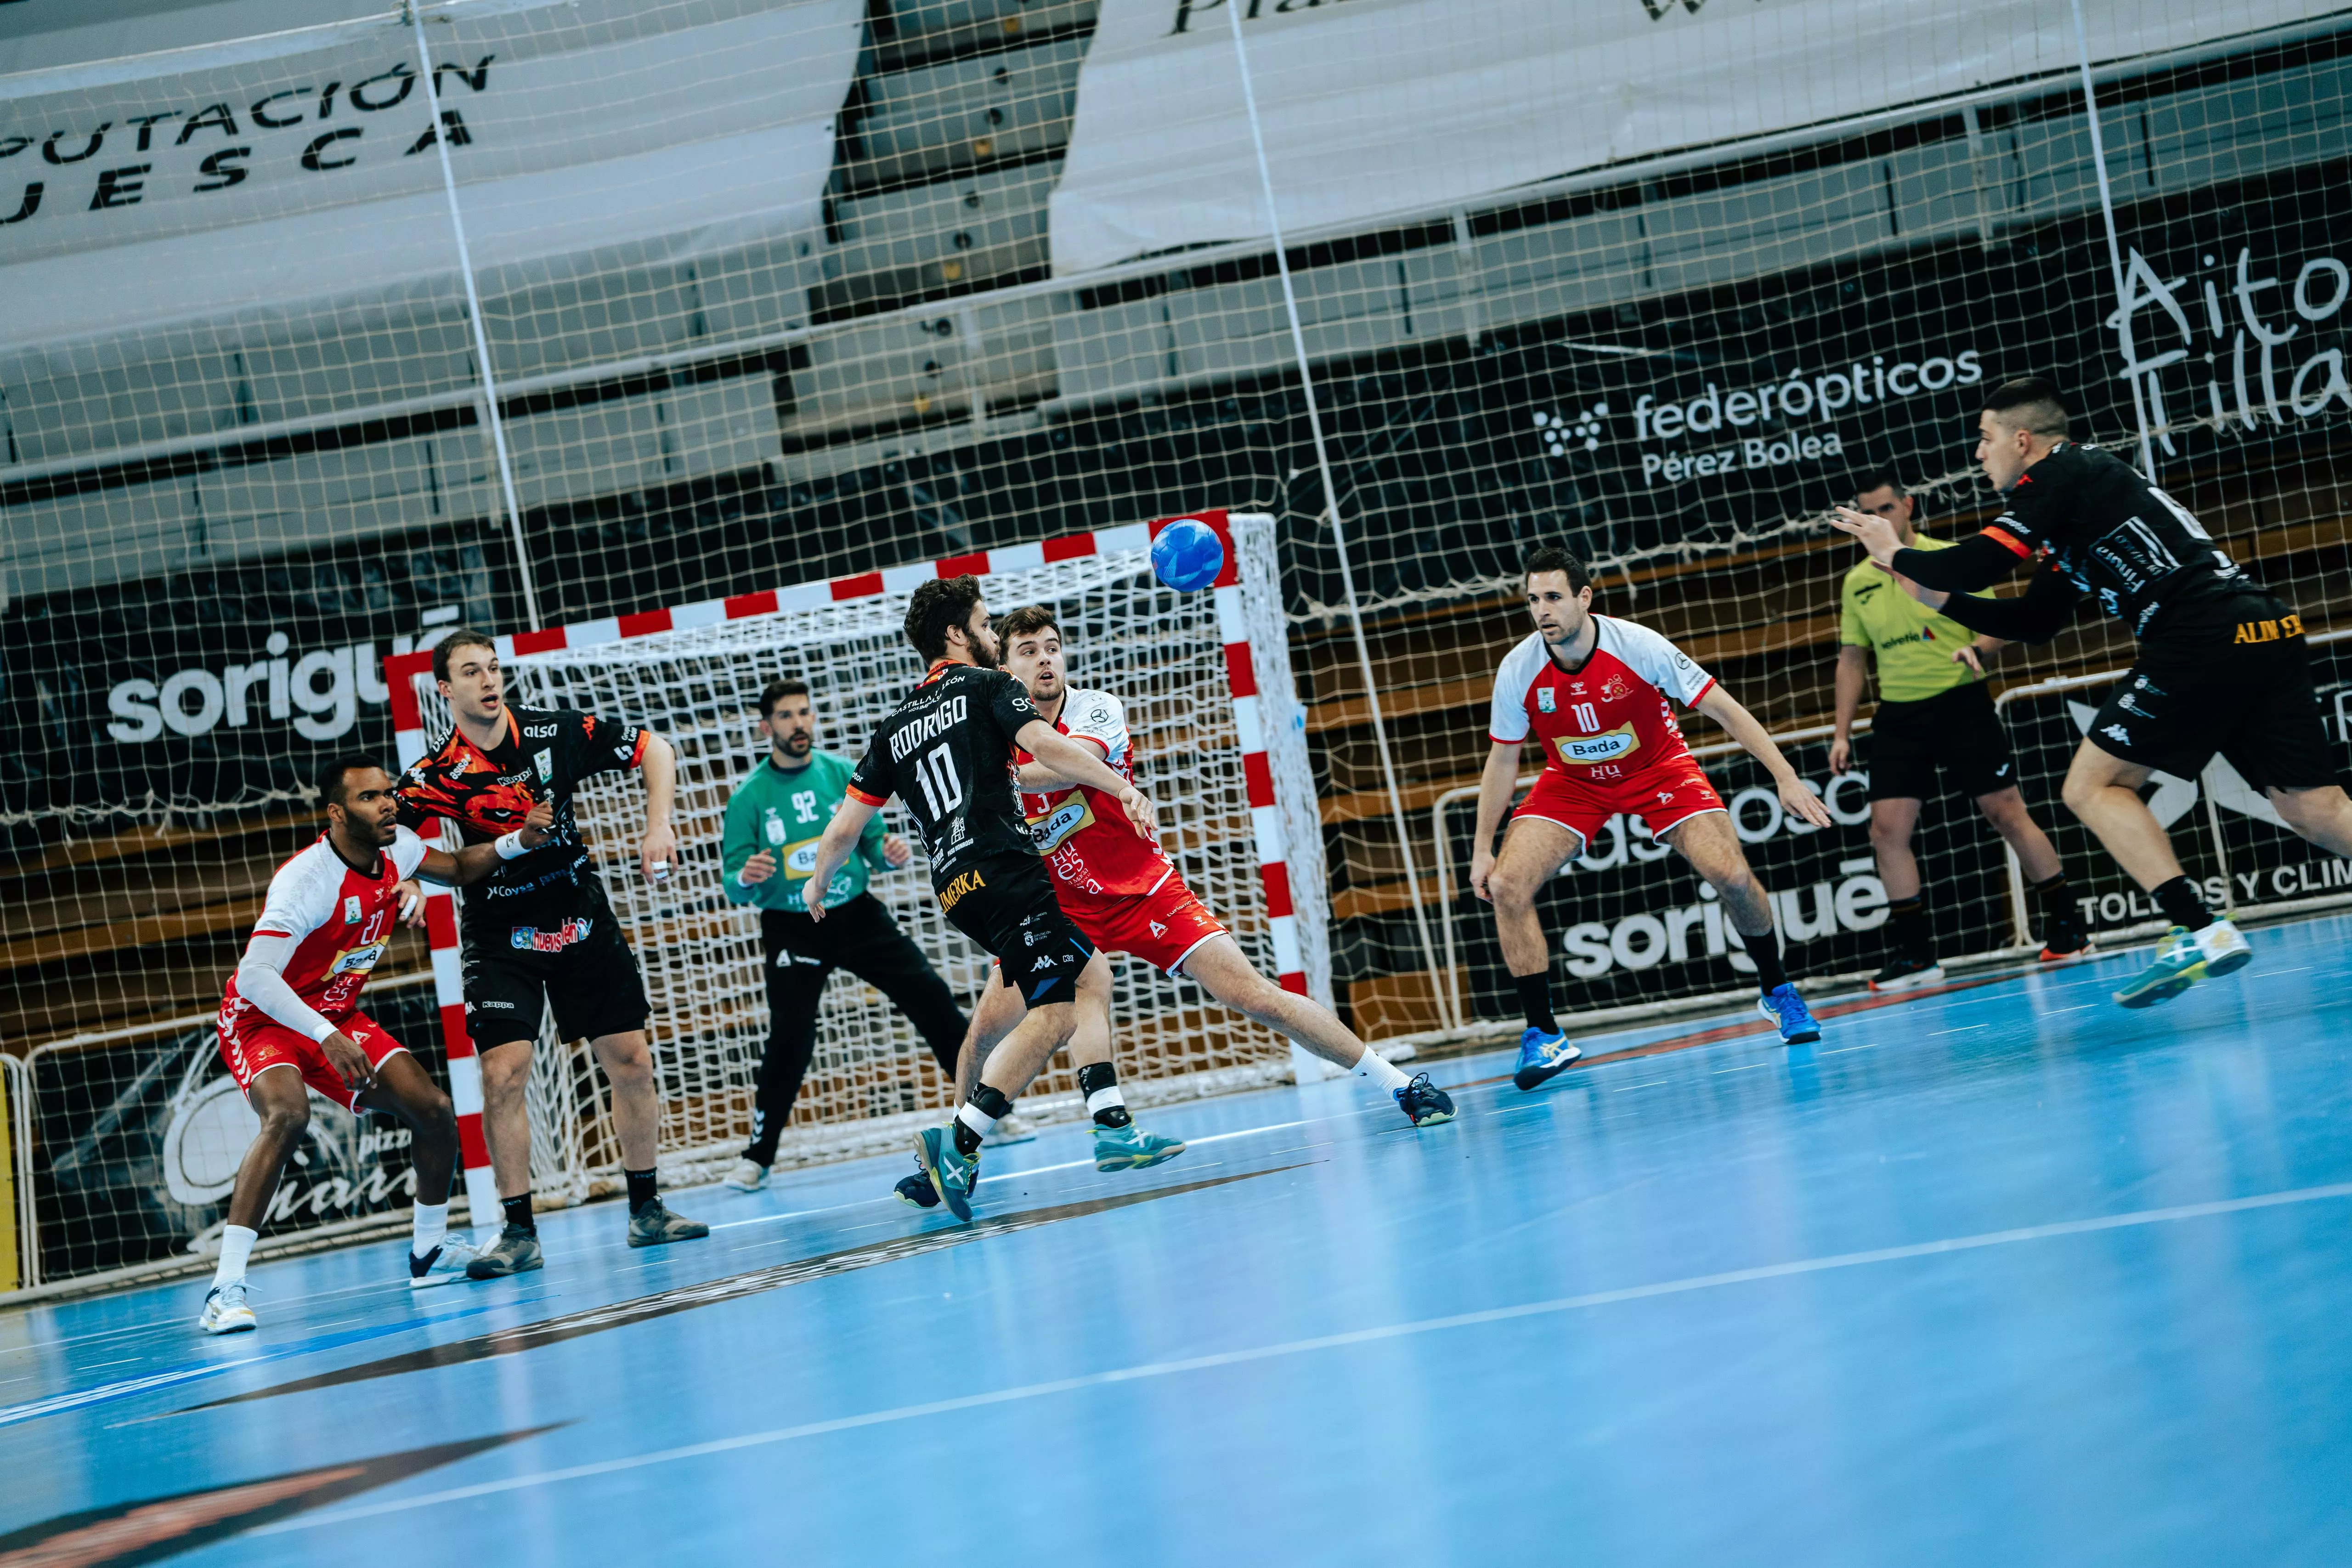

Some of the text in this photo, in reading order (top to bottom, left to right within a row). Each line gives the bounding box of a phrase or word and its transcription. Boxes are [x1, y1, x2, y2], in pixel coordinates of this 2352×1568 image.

[1633, 350, 1982, 441] federópticos
[1640, 430, 1841, 485] Pérez Bolea
[891, 695, 932, 717] CASTILLA
[942, 675, 965, 690] LEÓN
[524, 723, 558, 738] alsa
[889, 695, 967, 764] RODRIGO
[1571, 702, 1600, 733] 10
[1573, 740, 1620, 756] Bada
[916, 742, 962, 822] 10
[791, 790, 819, 824] 92
[1032, 811, 1072, 843] Bada
[797, 850, 816, 864] Ba
[1166, 900, 1192, 917] turismo
[2076, 877, 2227, 924] TOLS
[2236, 872, 2259, 900] Y
[361, 909, 384, 945] 27
[482, 1001, 514, 1009] Kappa
[358, 1126, 412, 1163] pizz
